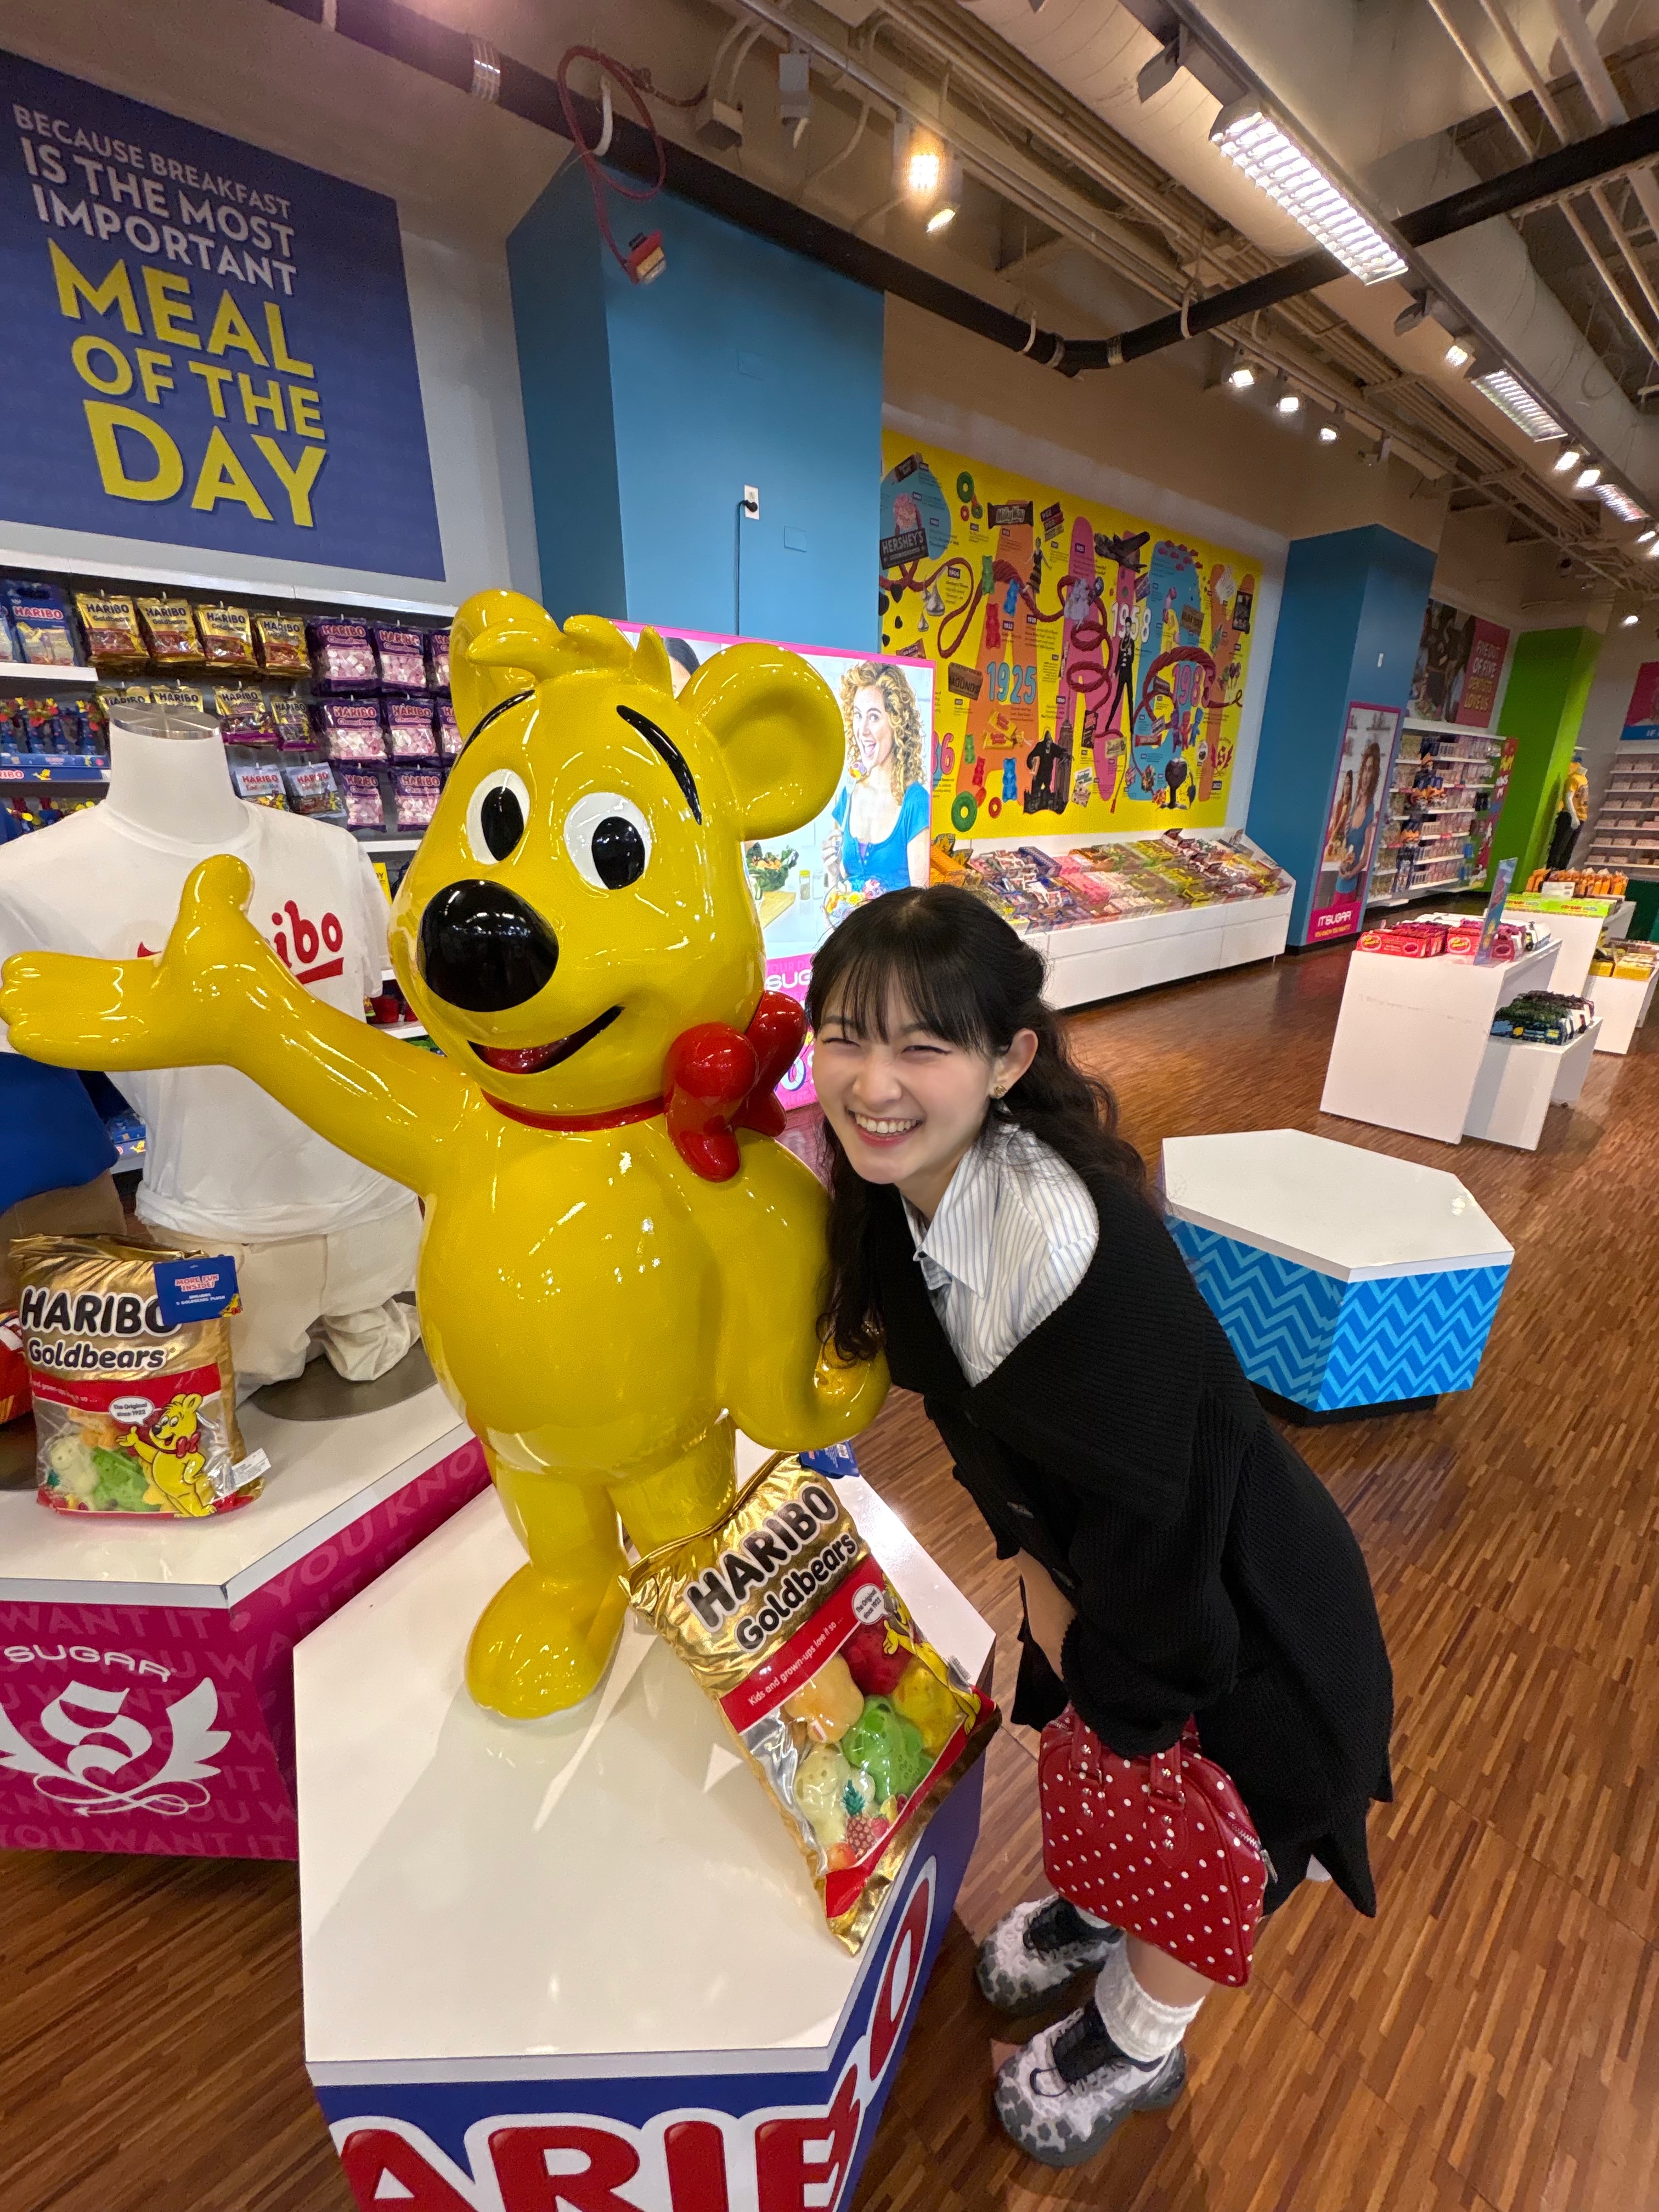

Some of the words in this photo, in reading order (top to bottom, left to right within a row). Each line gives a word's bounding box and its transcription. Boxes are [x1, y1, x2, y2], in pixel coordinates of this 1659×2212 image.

[13, 104, 144, 170] BECAUSE
[149, 152, 291, 218] BREAKFAST
[21, 137, 65, 183] IS
[72, 156, 170, 218] THE
[179, 190, 295, 258] MOST
[32, 184, 297, 296] IMPORTANT
[48, 237, 315, 379] MEAL
[71, 334, 175, 404] OF
[189, 360, 326, 441] THE
[83, 400, 326, 528] DAY
[882, 531, 924, 554] HERSHEY'S
[14, 606, 64, 619] HARIBO
[86, 603, 129, 614] HARIBO
[146, 607, 187, 617] HARIBO
[207, 612, 246, 624] HARIBO
[1111, 602, 1152, 644] 1958
[264, 620, 301, 633] HARIBO
[322, 625, 366, 637] HARIBO
[380, 630, 421, 645] HARIBO
[987, 661, 1037, 704] 1925
[159, 691, 199, 703] HARIBO
[222, 691, 258, 701] HARIBO
[275, 701, 307, 712] HARIBO
[333, 706, 377, 718] HARIBO
[392, 705, 432, 717] HARIBO
[242, 774, 279, 785] HARIBO
[346, 774, 378, 787] HARIBO
[402, 775, 440, 787] HARIBO
[182, 1282, 214, 1291] INSIDE!
[28, 1338, 165, 1370] Goldbears
[123, 1402, 148, 1410] Original
[261, 1513, 375, 1609] YOU
[383, 1444, 479, 1530] KNO
[687, 1483, 839, 1632] HARIBO
[736, 1531, 858, 1652] Goldbears
[855, 1602, 865, 1613] The
[862, 1587, 877, 1606] Original
[748, 1690, 766, 1707] Kids
[765, 1677, 781, 1694] and
[780, 1646, 816, 1683] grown-ups
[815, 1633, 827, 1649] love
[822, 1627, 831, 1637] it
[828, 1621, 837, 1632] so
